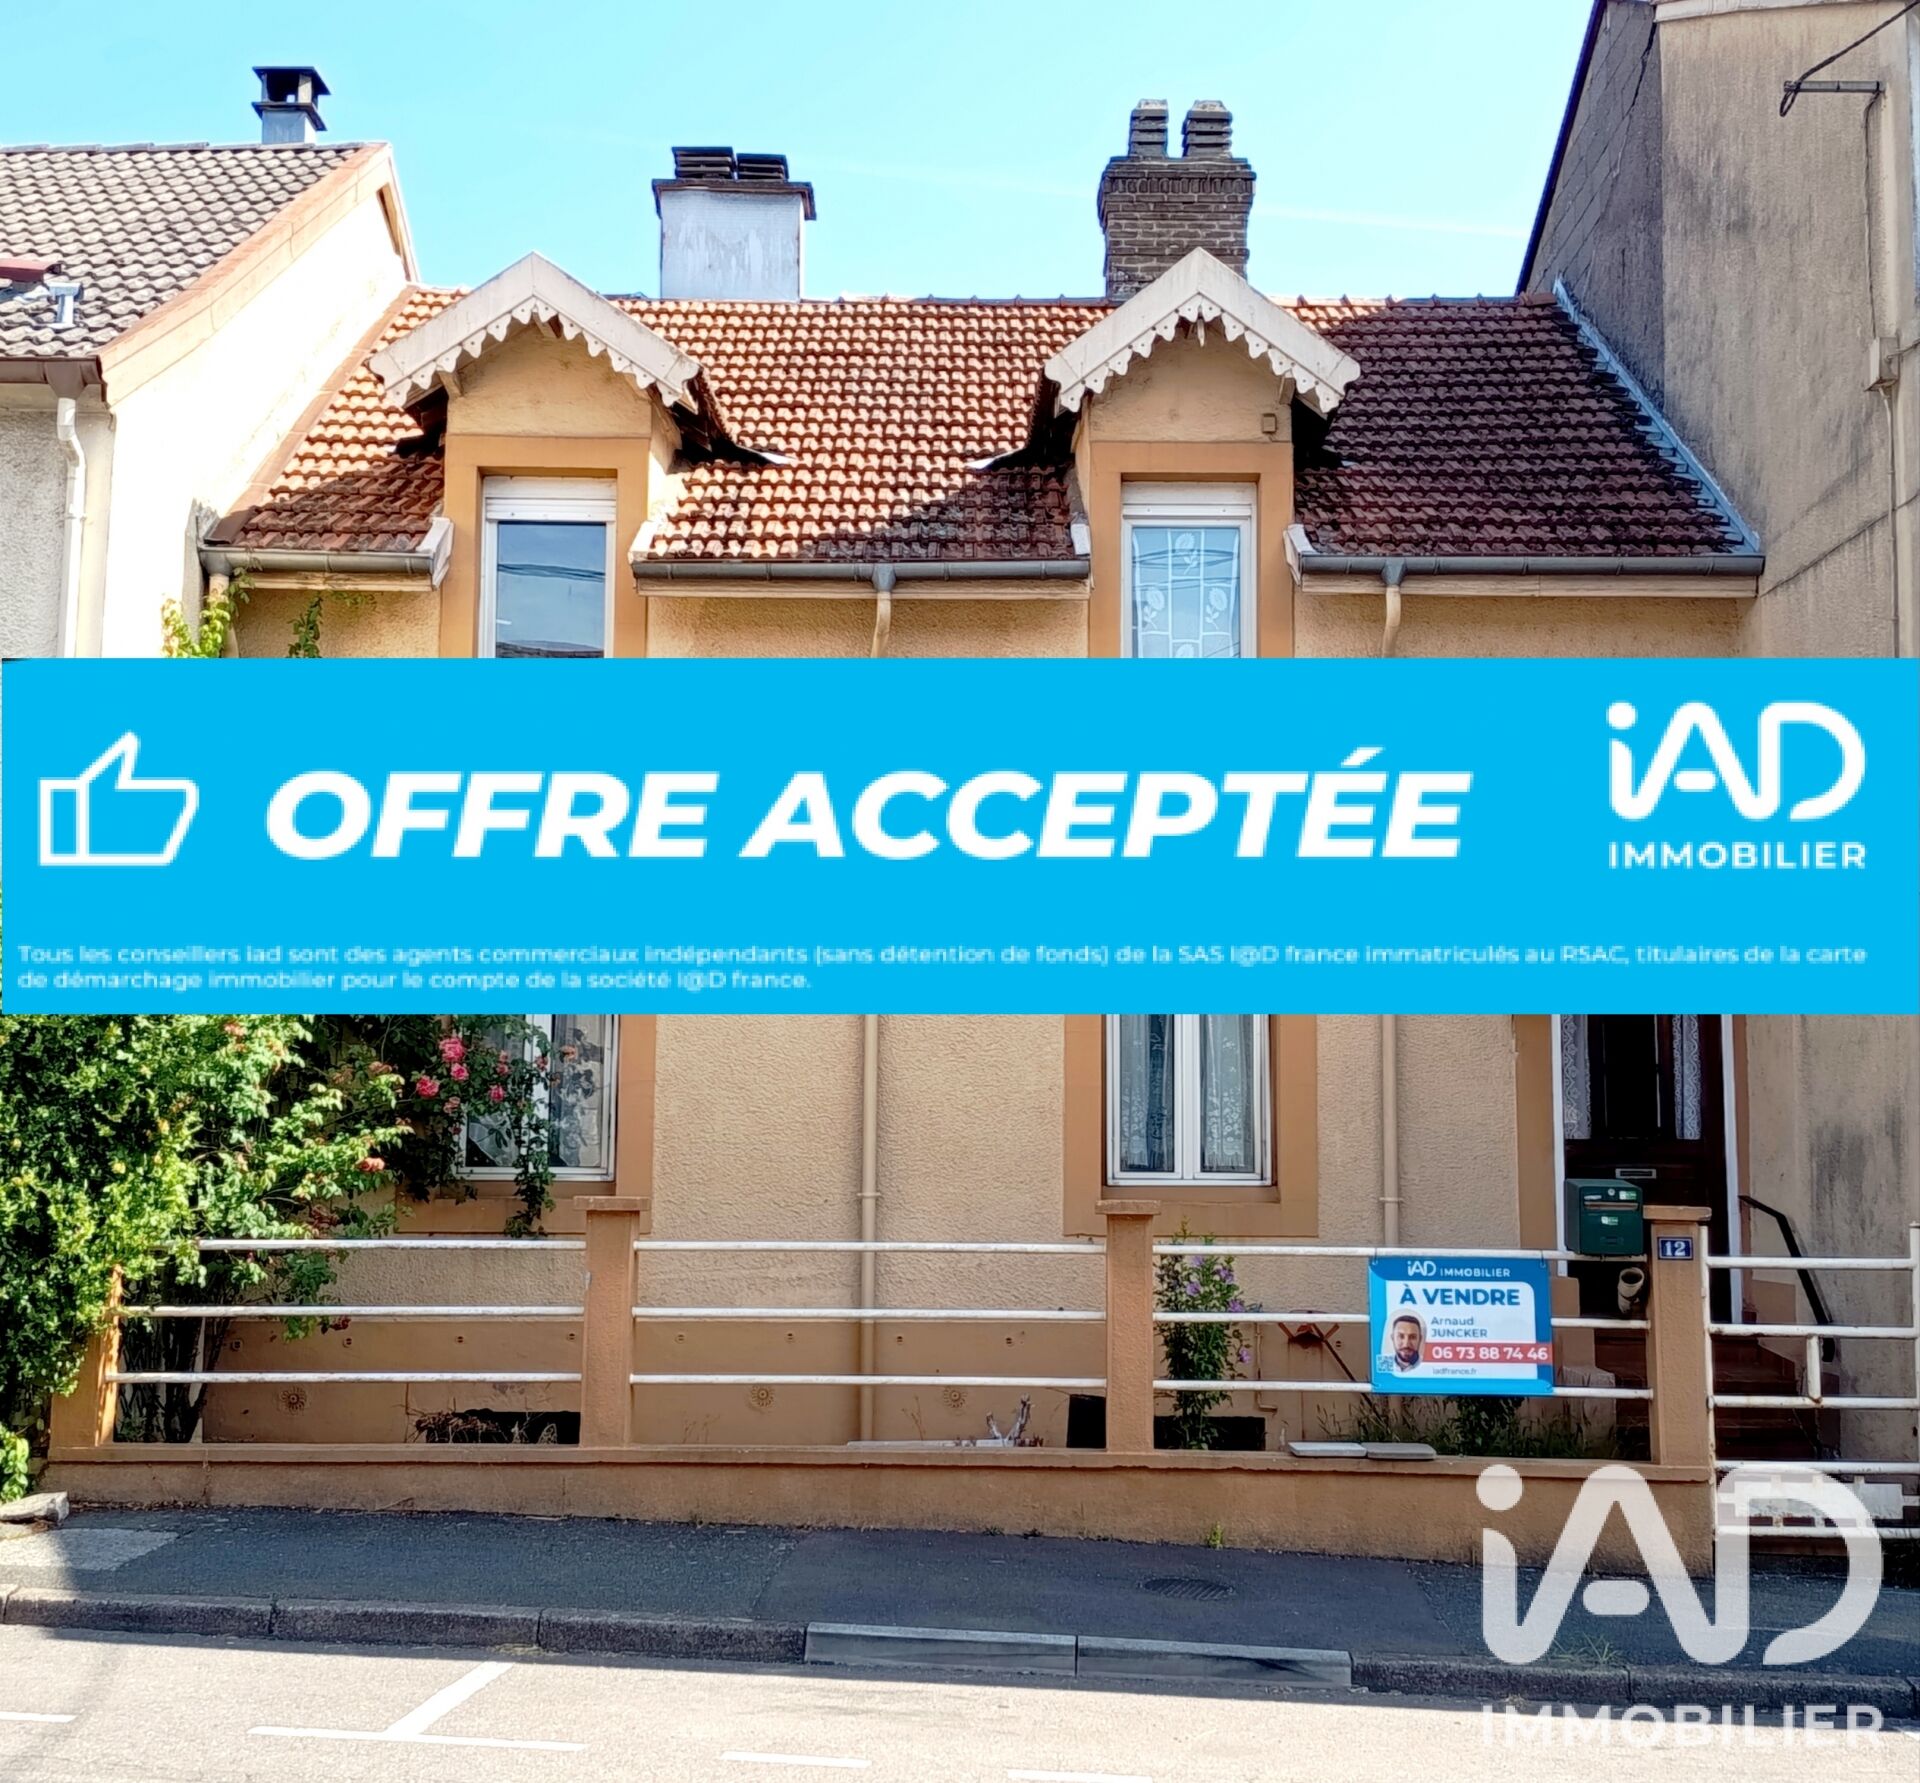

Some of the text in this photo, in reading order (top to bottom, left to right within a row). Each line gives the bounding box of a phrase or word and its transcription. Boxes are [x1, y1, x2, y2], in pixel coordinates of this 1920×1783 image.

[1665, 1241, 1686, 1257] 12
[1440, 1268, 1511, 1277] IMMOBILIER
[1400, 1284, 1521, 1306] À VENDRE
[1431, 1317, 1474, 1326] Arnaud
[1431, 1328, 1488, 1338] JUNCKER
[1432, 1346, 1548, 1360] 06 73 88 74 46
